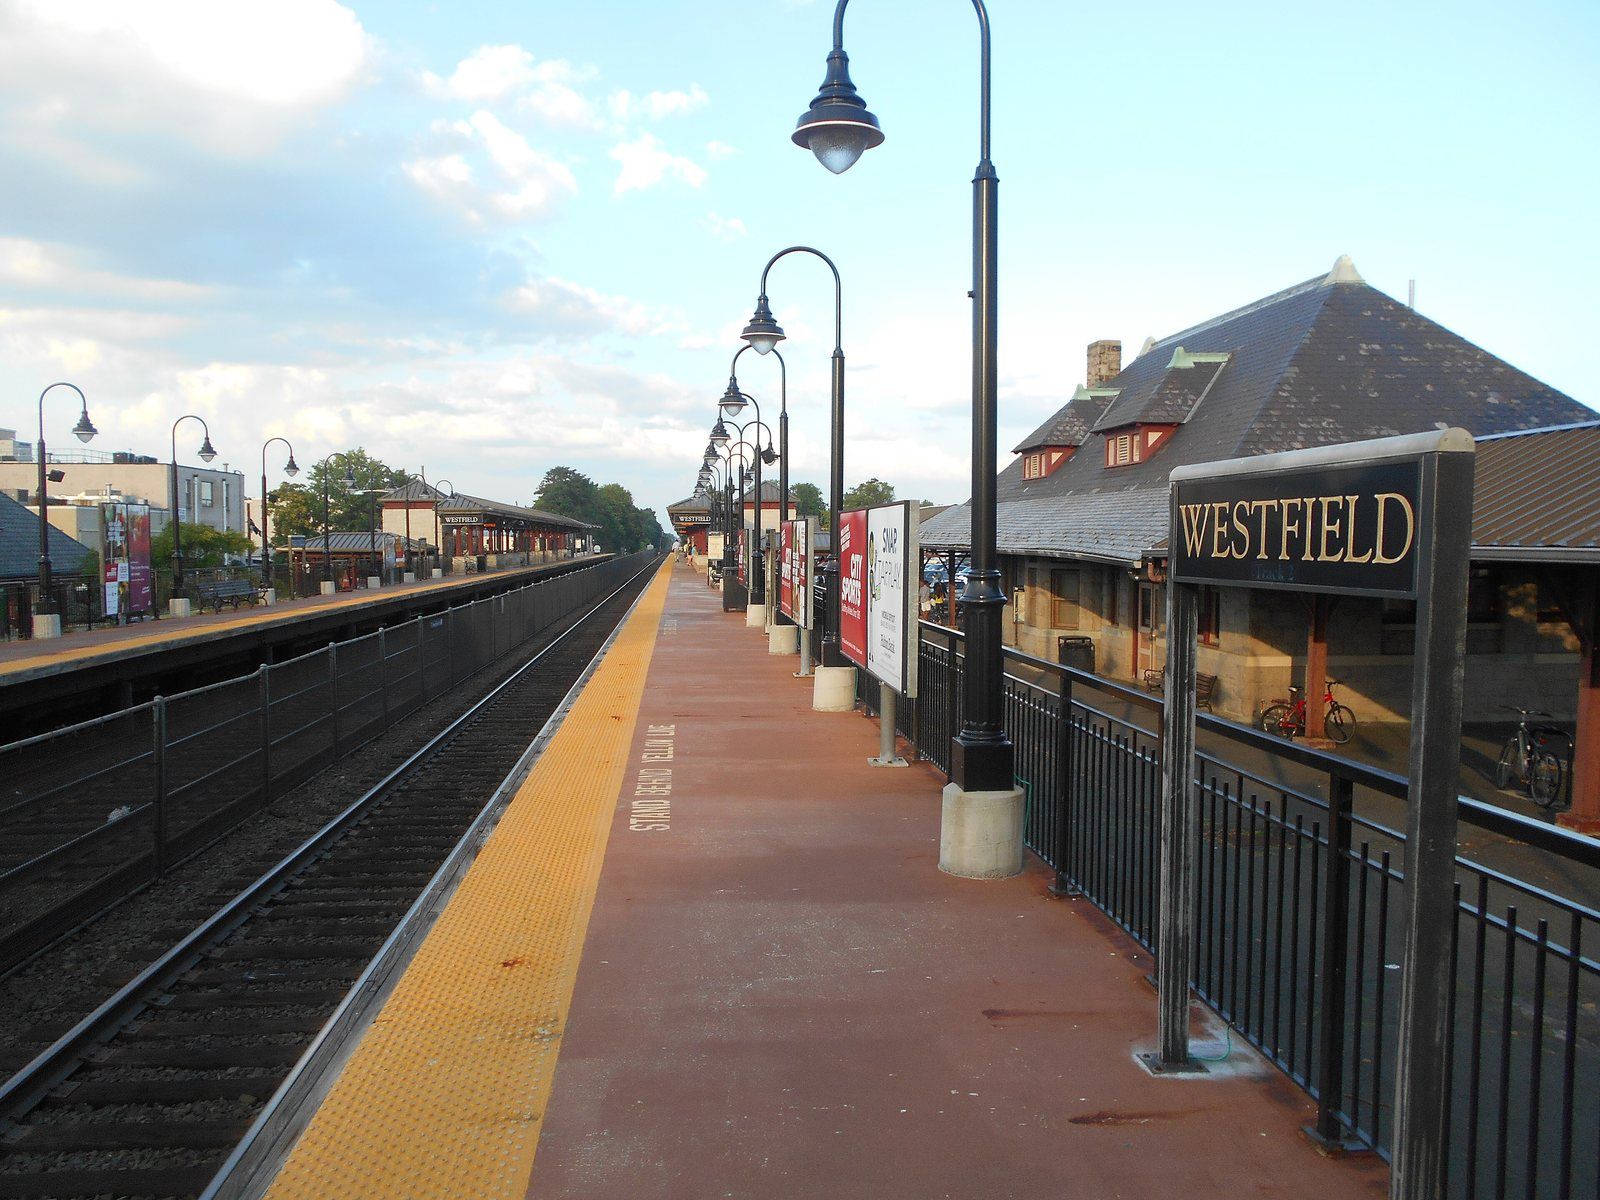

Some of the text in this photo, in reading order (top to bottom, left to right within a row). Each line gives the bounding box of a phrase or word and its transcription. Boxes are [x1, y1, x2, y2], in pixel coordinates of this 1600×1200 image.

[1179, 492, 1415, 565] WESTFIELD
[850, 553, 863, 581] CITY
[841, 576, 862, 607] SPORTS
[640, 738, 674, 763] YELLOW
[633, 768, 673, 796] BEHIND
[629, 799, 671, 831] STAND
